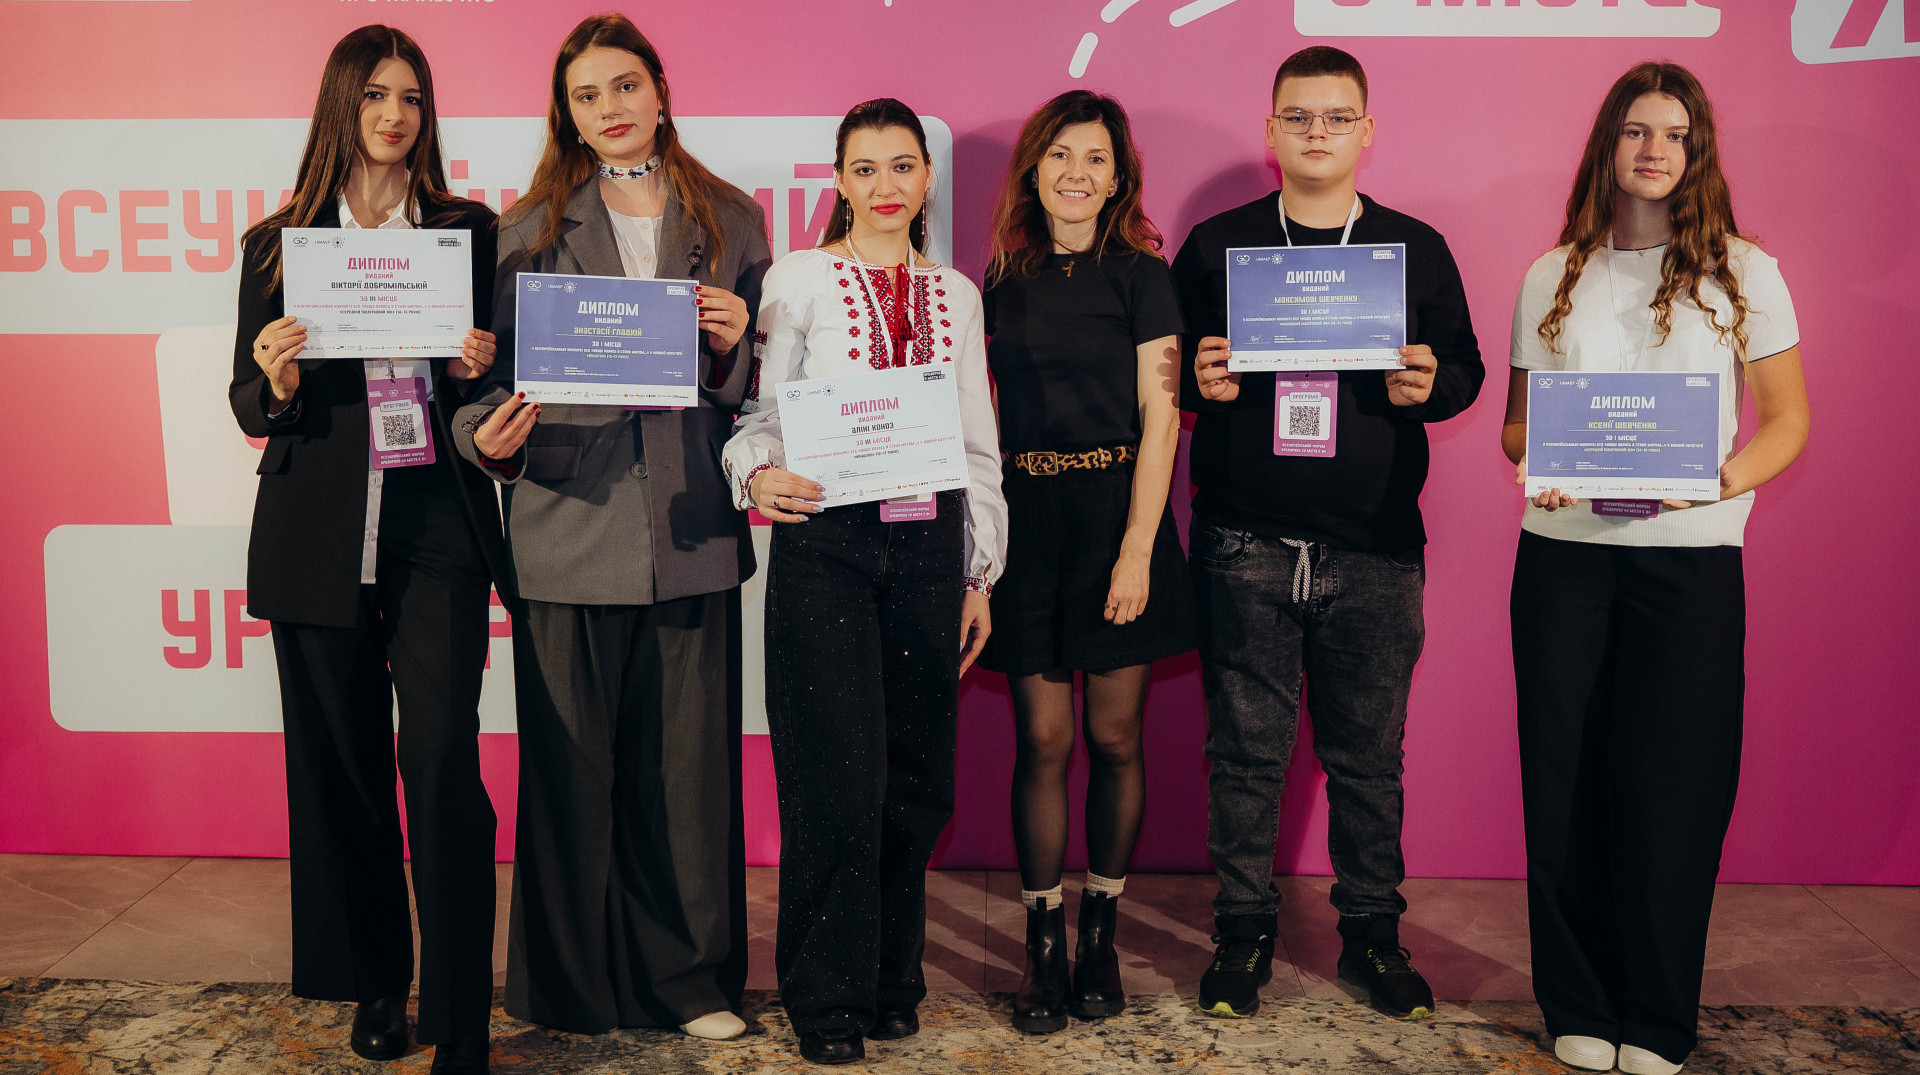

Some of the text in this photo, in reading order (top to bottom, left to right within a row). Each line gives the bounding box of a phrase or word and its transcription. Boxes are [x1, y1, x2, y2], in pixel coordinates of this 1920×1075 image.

[347, 257, 410, 270] ДИПЛОМ
[1286, 270, 1346, 284] ДИПЛОМ
[331, 280, 428, 290] ВІКТОРІЇ ДОБРОМІЛЬСЬКІЙ
[578, 301, 639, 317] ДИПЛОМ
[840, 396, 900, 417] ДИПЛОМ
[1590, 396, 1656, 409] ДИПЛОМ
[872, 423, 894, 432] КОНОЗ
[1589, 420, 1657, 430] КСЕНІЇ ШЕВЧЕНКО
[872, 436, 892, 444] МІСЦЕ
